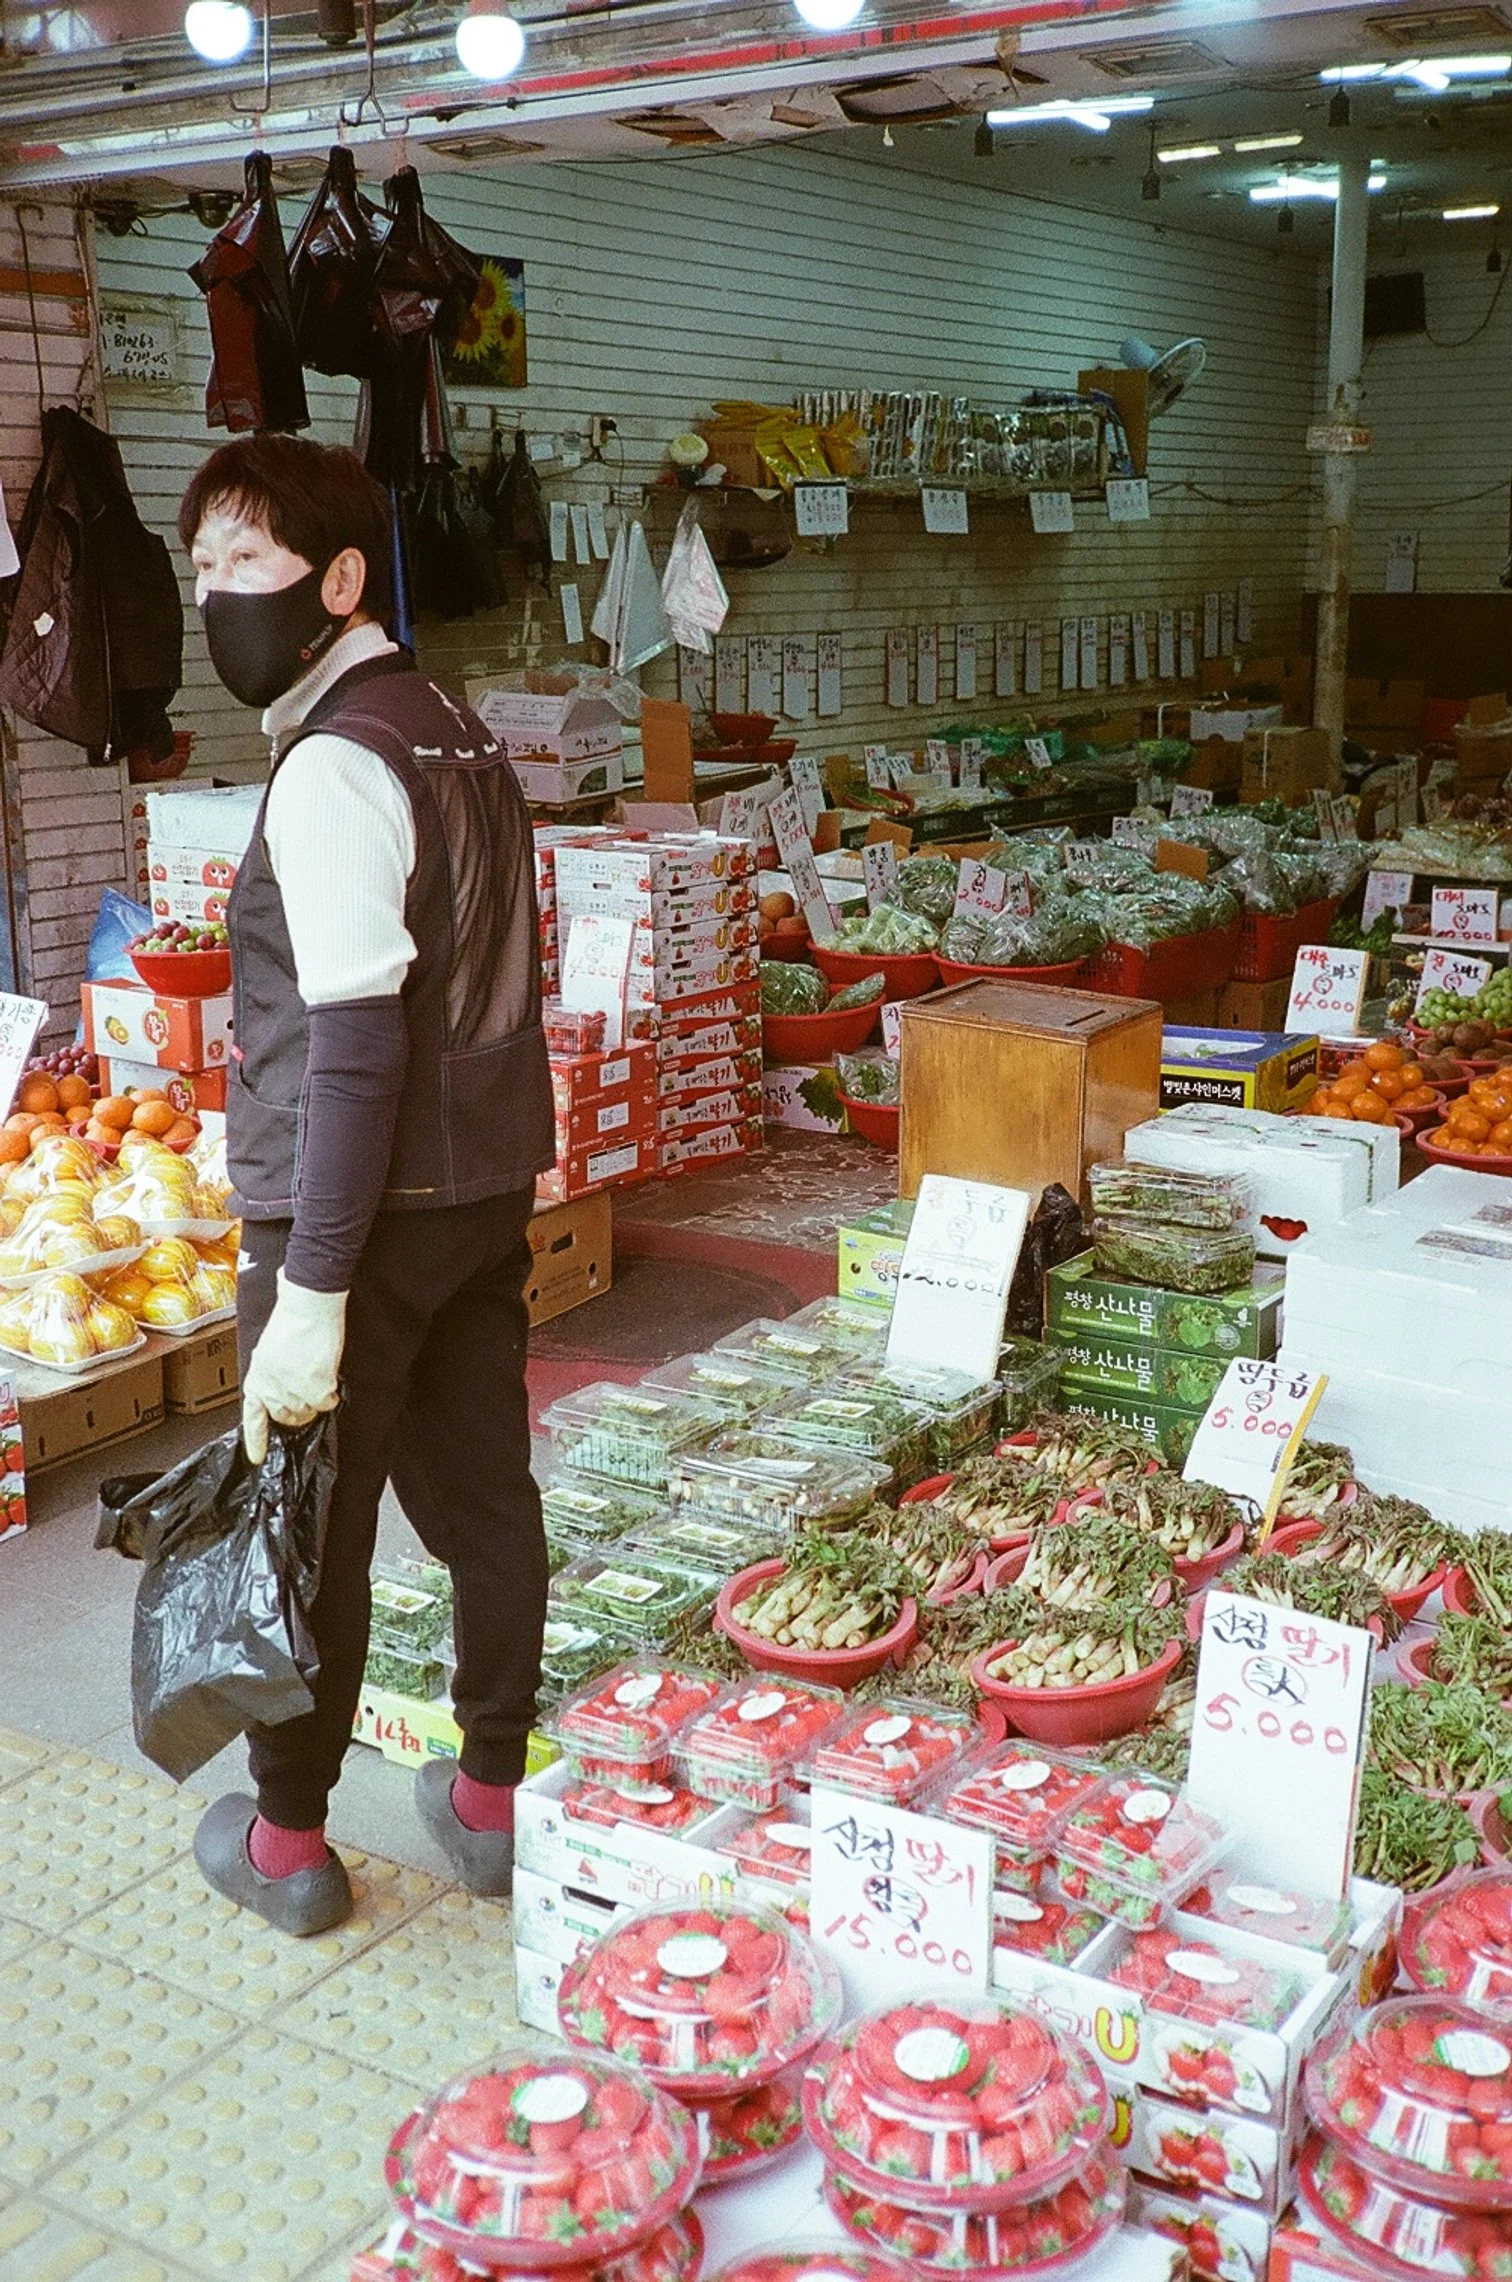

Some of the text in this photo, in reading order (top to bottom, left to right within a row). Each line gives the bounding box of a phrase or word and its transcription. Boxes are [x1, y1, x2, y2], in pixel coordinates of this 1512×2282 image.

[1064, 1291, 1157, 1338] 평창 산나물
[1094, 1349, 1154, 1392] 산나물
[1238, 1362, 1312, 1399] 땅두릅
[1280, 1625, 1351, 1689] 딸기
[905, 1837, 975, 1907] 딸기
